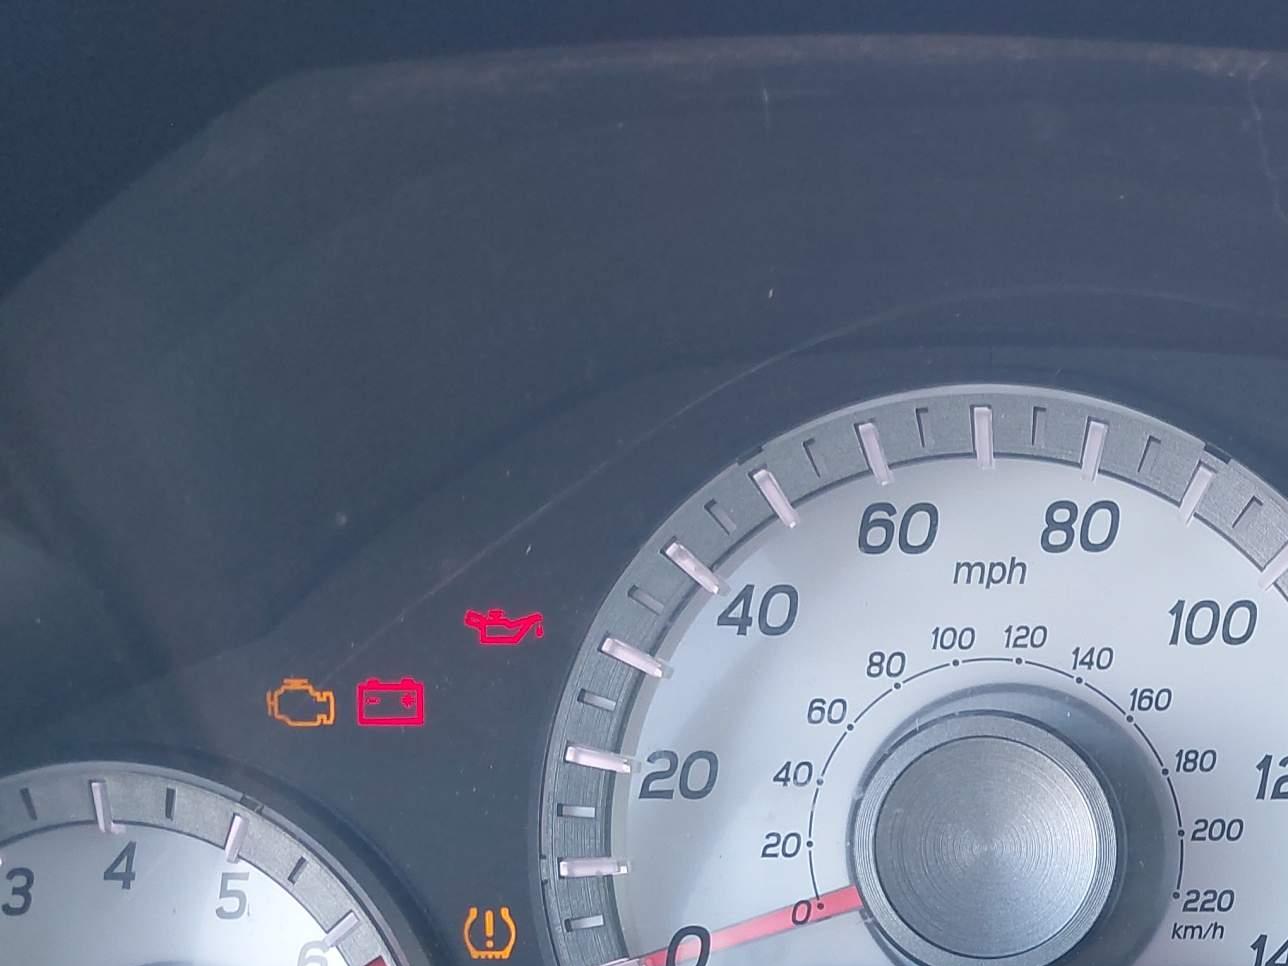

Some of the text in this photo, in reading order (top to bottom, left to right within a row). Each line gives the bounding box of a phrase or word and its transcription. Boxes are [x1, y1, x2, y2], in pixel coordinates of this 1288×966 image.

[858, 502, 939, 554] 60
[1040, 500, 1120, 553] 80
[953, 557, 1027, 586] mph
[717, 584, 799, 635] 40
[1168, 599, 1257, 646] 100
[931, 627, 975, 650] 100
[1004, 625, 1047, 649] 120
[866, 652, 906, 677] 80
[1071, 647, 1114, 671] 140
[807, 699, 848, 724] 60
[1129, 688, 1173, 711] 160
[1175, 750, 1217, 773] 180
[638, 750, 719, 800] 20
[773, 762, 813, 787] 40
[1191, 819, 1244, 842] 200
[761, 833, 802, 858] 20
[103, 841, 137, 890] 4
[1, 867, 35, 916] 3
[215, 872, 250, 919] 5
[1182, 890, 1234, 913] 220
[791, 901, 811, 925] 0
[1171, 921, 1225, 941] km/h
